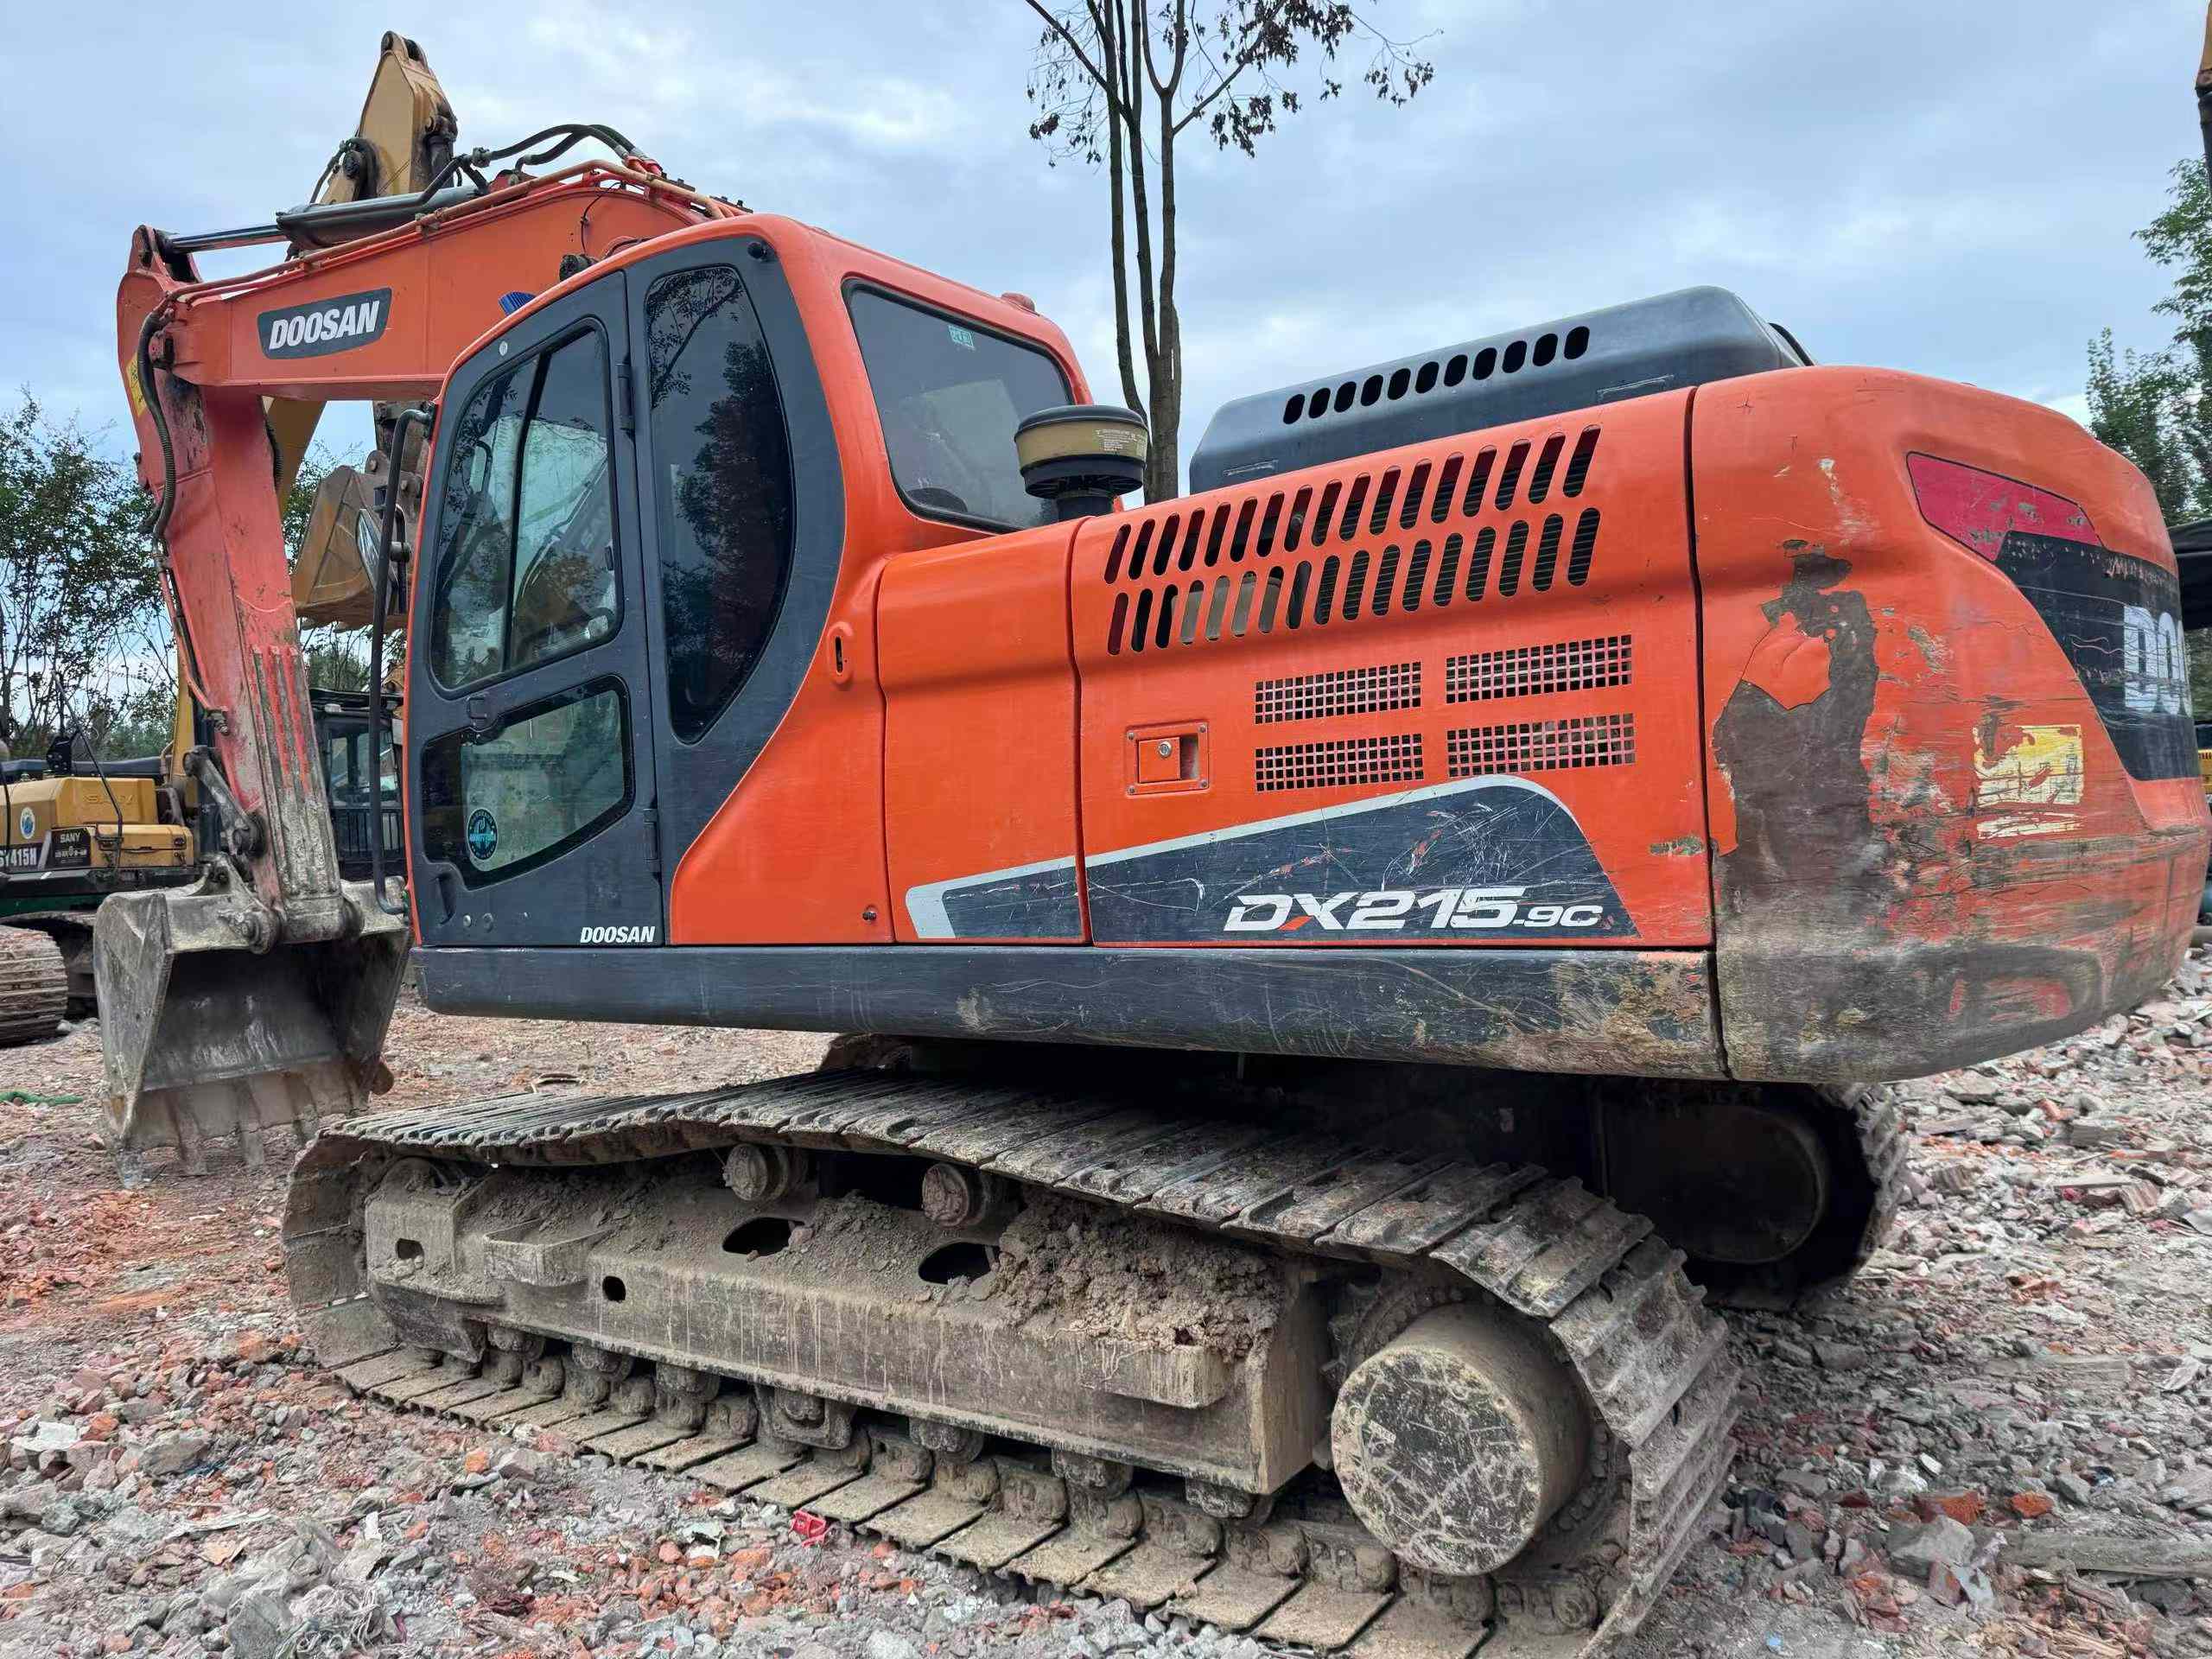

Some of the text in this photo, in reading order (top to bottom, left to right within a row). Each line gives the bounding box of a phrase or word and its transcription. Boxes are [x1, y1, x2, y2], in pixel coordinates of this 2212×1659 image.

[269, 300, 380, 350] DOOSAN
[60, 832, 80, 843] SANY
[580, 925, 656, 944] DOOSAN
